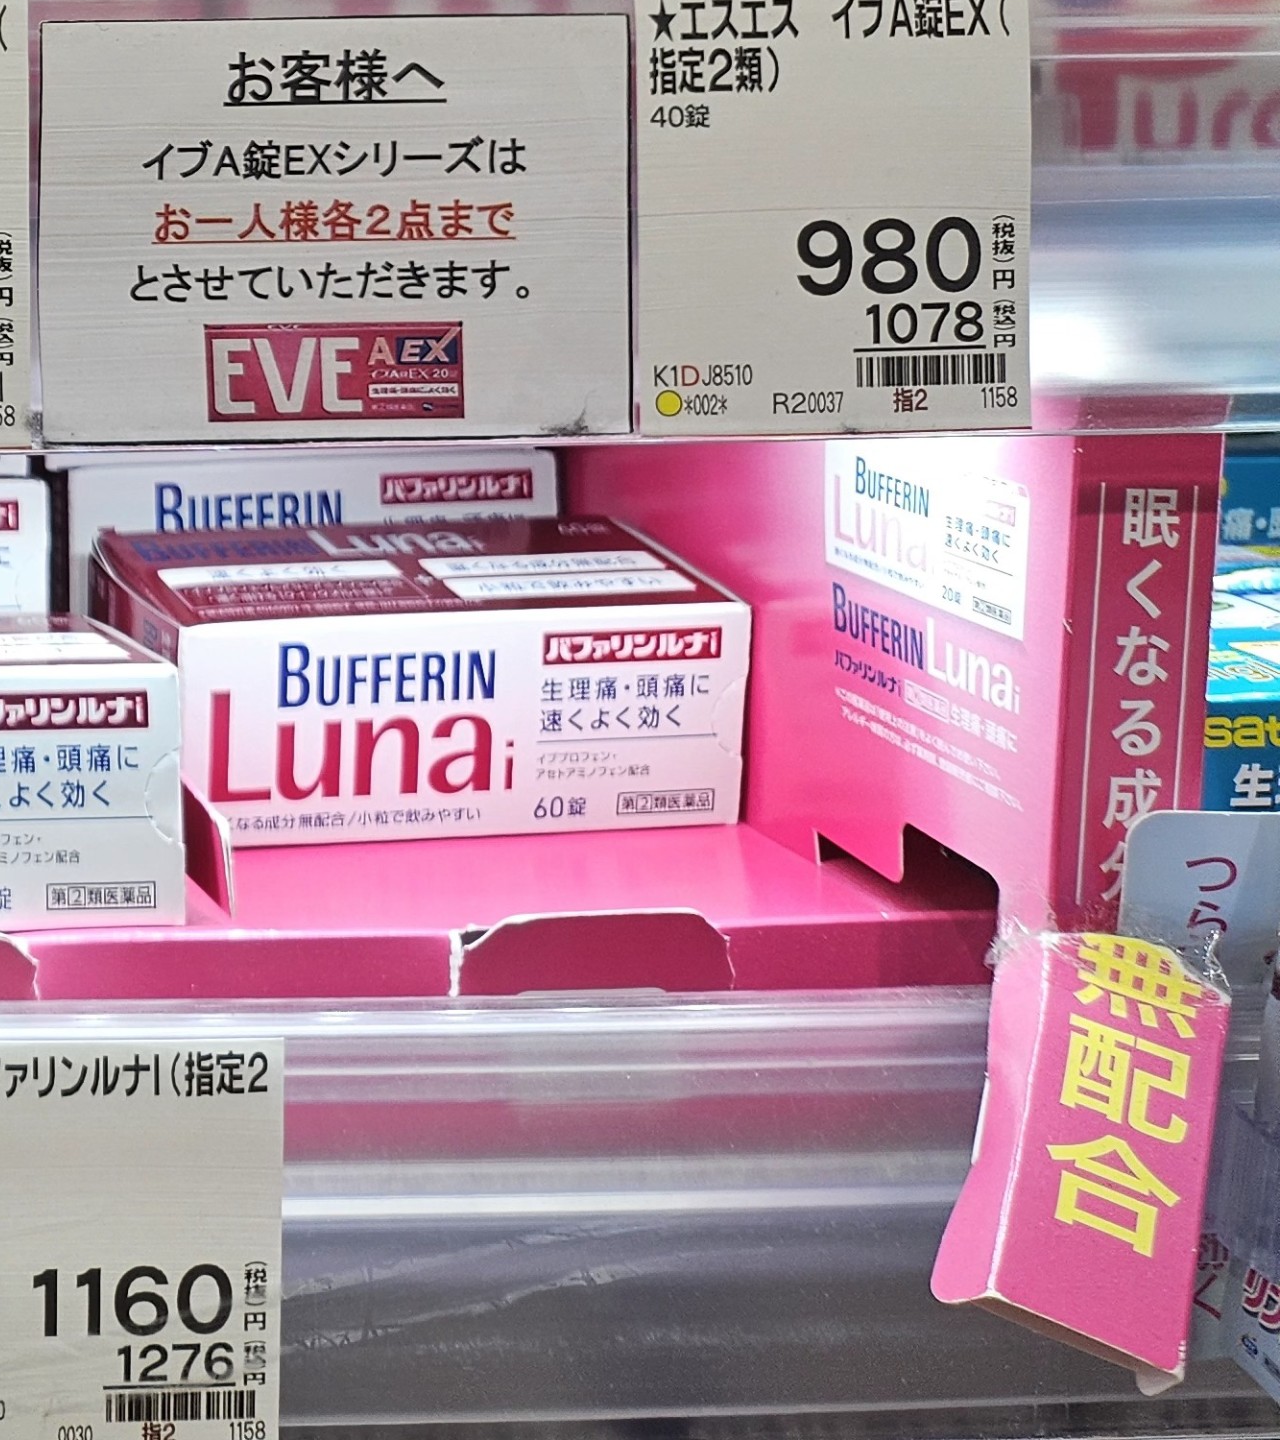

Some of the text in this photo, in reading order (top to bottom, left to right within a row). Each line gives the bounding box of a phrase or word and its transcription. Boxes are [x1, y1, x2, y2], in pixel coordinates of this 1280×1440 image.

[226, 48, 445, 101] お客様へ
[650, 104, 711, 128] 40錠
[141, 136, 528, 181] イブA錠EXシリーズは
[154, 199, 515, 241] お一人様各2点まで
[796, 216, 982, 296] 980
[129, 259, 530, 302] とさせていただきます。
[865, 301, 985, 345] 1078
[533, 795, 586, 820] 60錠
[33, 1264, 234, 1336] 1160
[117, 1342, 235, 1382] 1276
